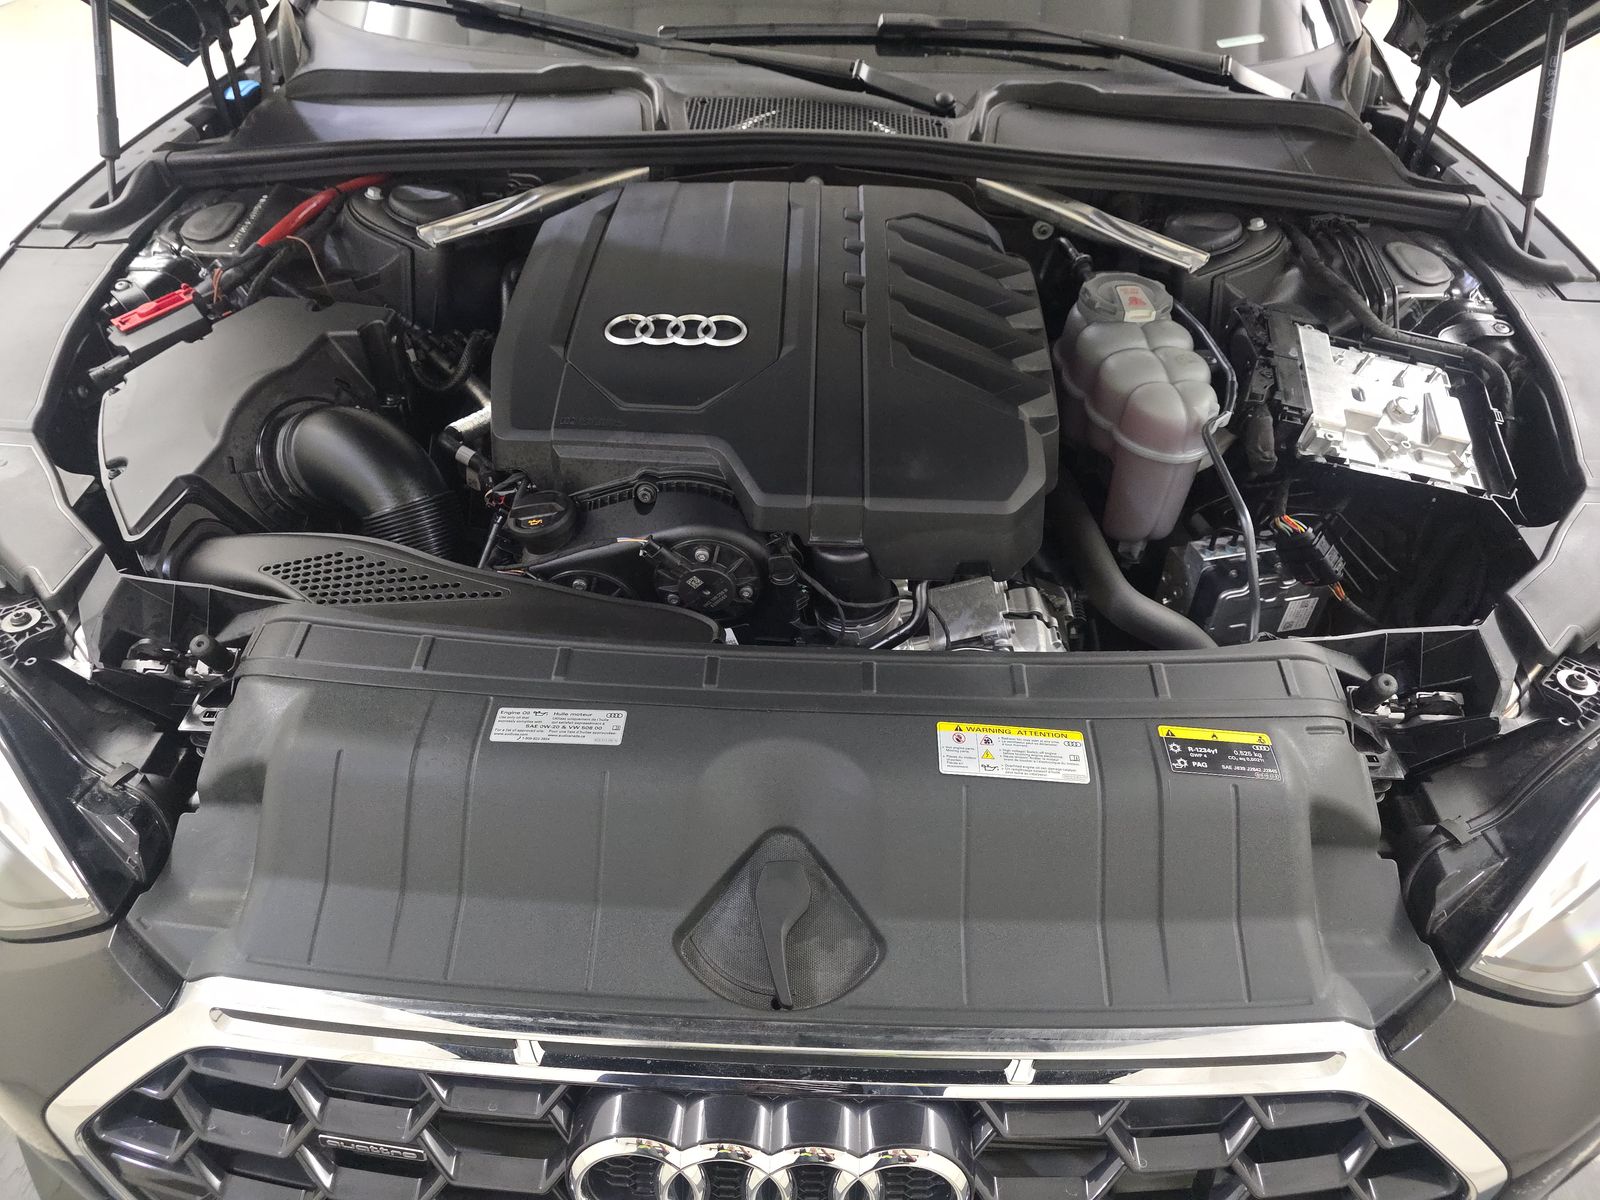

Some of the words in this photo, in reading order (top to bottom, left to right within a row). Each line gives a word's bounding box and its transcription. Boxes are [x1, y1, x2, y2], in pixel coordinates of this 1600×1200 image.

[966, 726, 1012, 734] WARNING
[1017, 730, 1068, 738] ATTENTION
[326, 1140, 417, 1159] quattro
